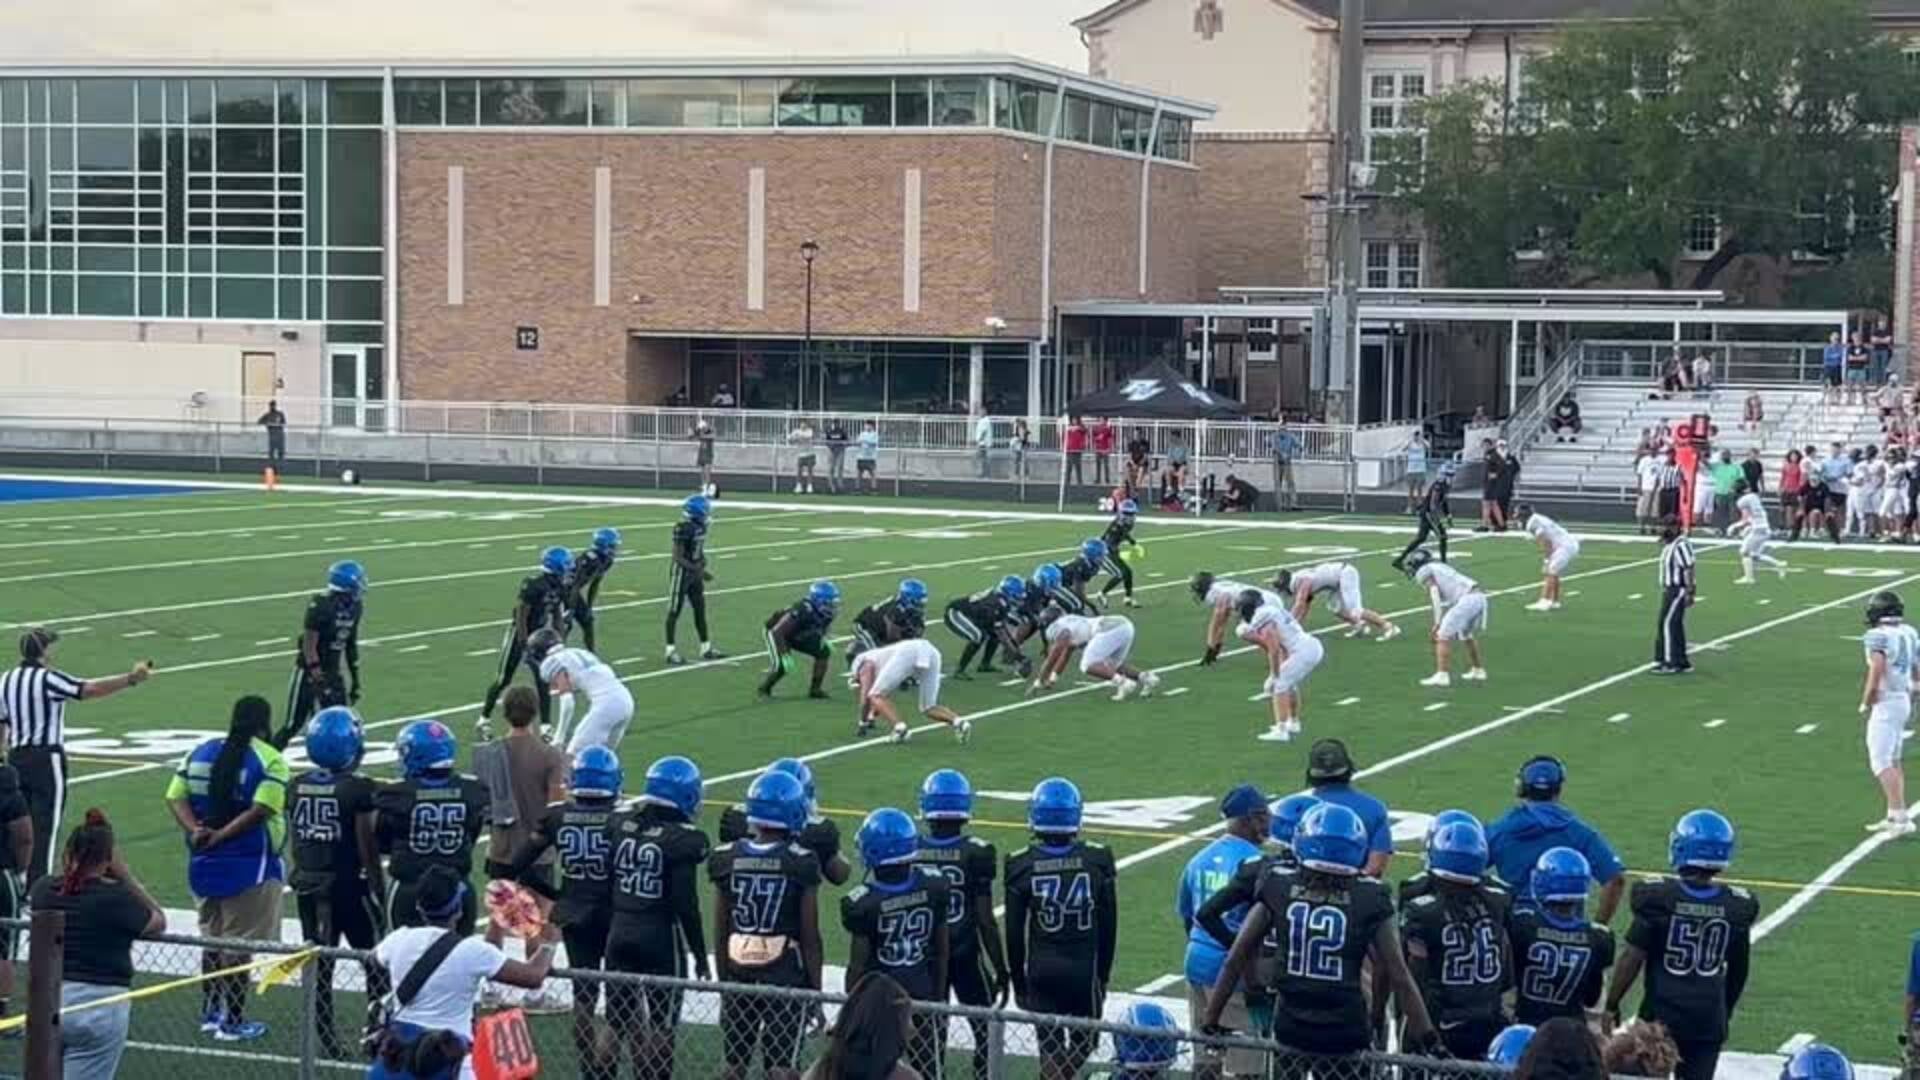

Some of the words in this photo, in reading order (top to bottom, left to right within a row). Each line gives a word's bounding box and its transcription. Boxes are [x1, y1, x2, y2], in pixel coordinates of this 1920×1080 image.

[520, 331, 537, 347] 12
[293, 797, 342, 842] 45
[409, 802, 466, 854] 65
[557, 825, 610, 880] 25
[614, 838, 664, 898] 42
[731, 873, 787, 933] 37
[1032, 872, 1095, 932] 34
[877, 907, 933, 967] 32
[1287, 901, 1347, 981] 12
[1442, 917, 1501, 985] 26
[1664, 914, 1730, 976] 50
[1522, 941, 1593, 1005] 27
[494, 1015, 533, 1071] 40
